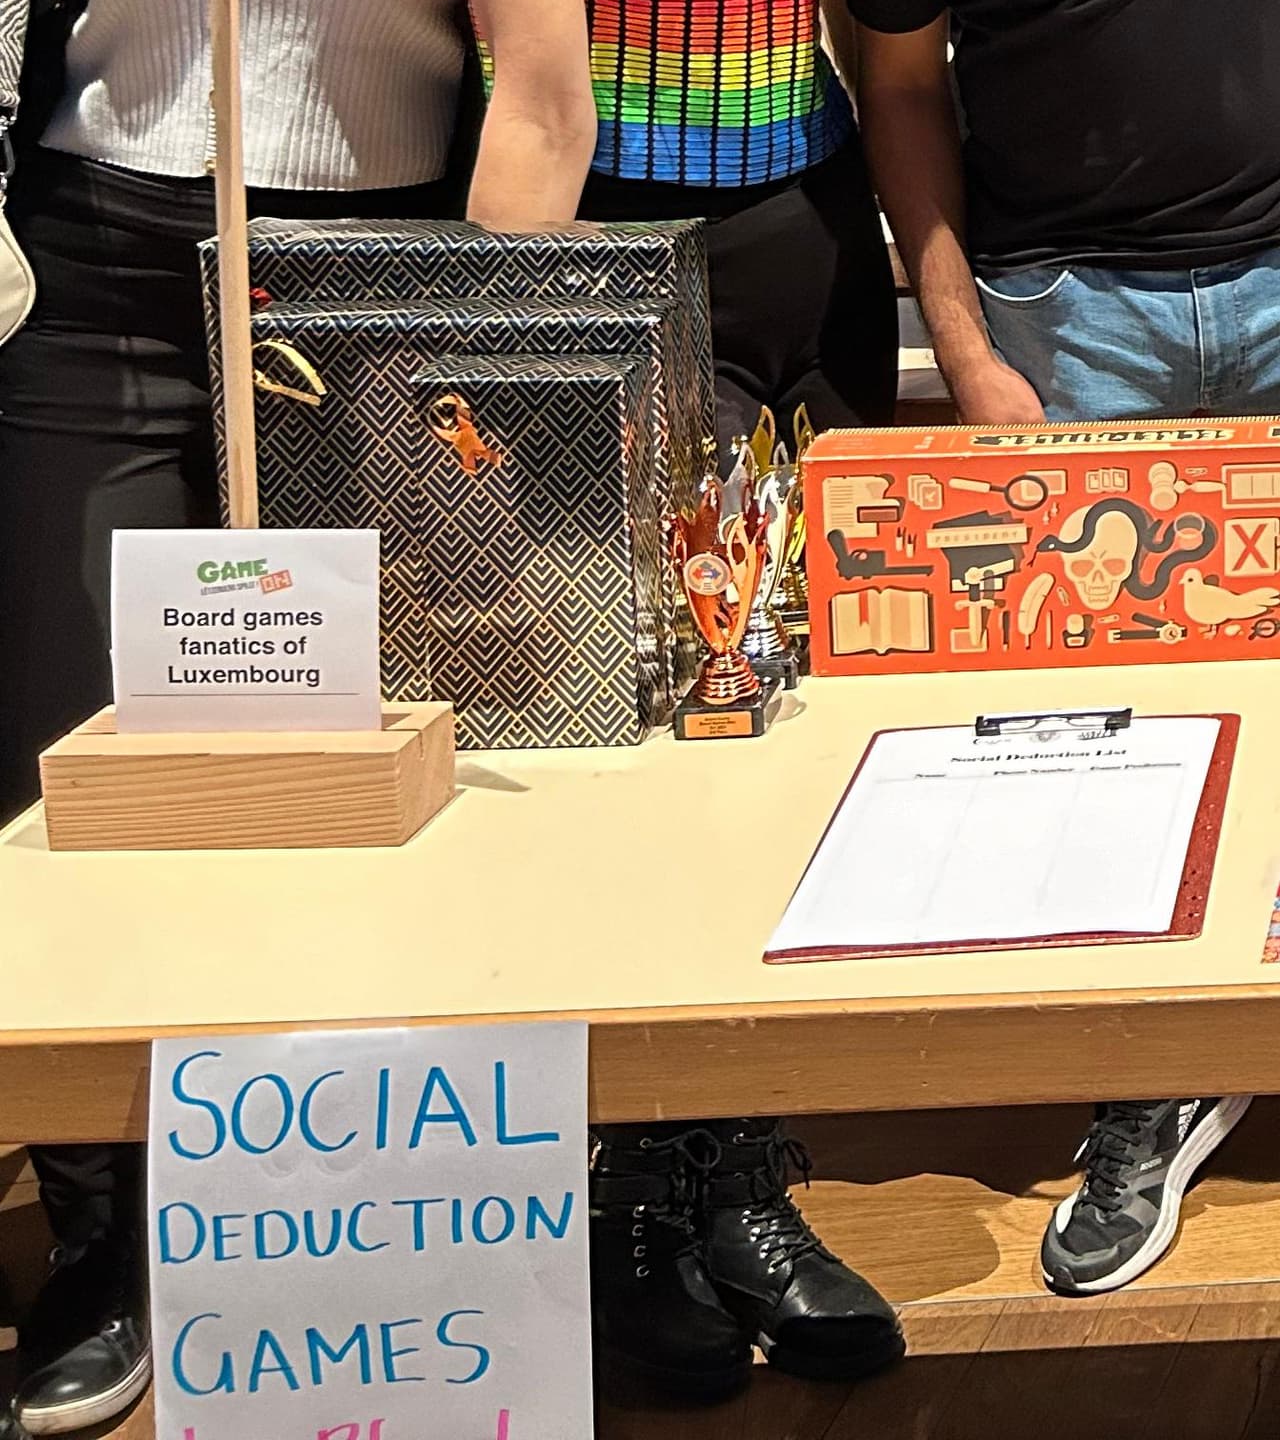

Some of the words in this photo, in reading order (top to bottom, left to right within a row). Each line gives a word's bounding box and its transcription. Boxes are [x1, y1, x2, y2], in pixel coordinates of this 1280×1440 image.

[197, 558, 268, 584] GAME
[163, 608, 235, 627] Board
[242, 611, 323, 631] games
[180, 636, 275, 656] fanatics
[283, 635, 307, 655] of
[168, 665, 320, 687] Luxembourg
[168, 1050, 560, 1160] SOCIAL
[158, 1191, 574, 1264] DEDUCTION
[171, 1309, 491, 1396] GAMES
